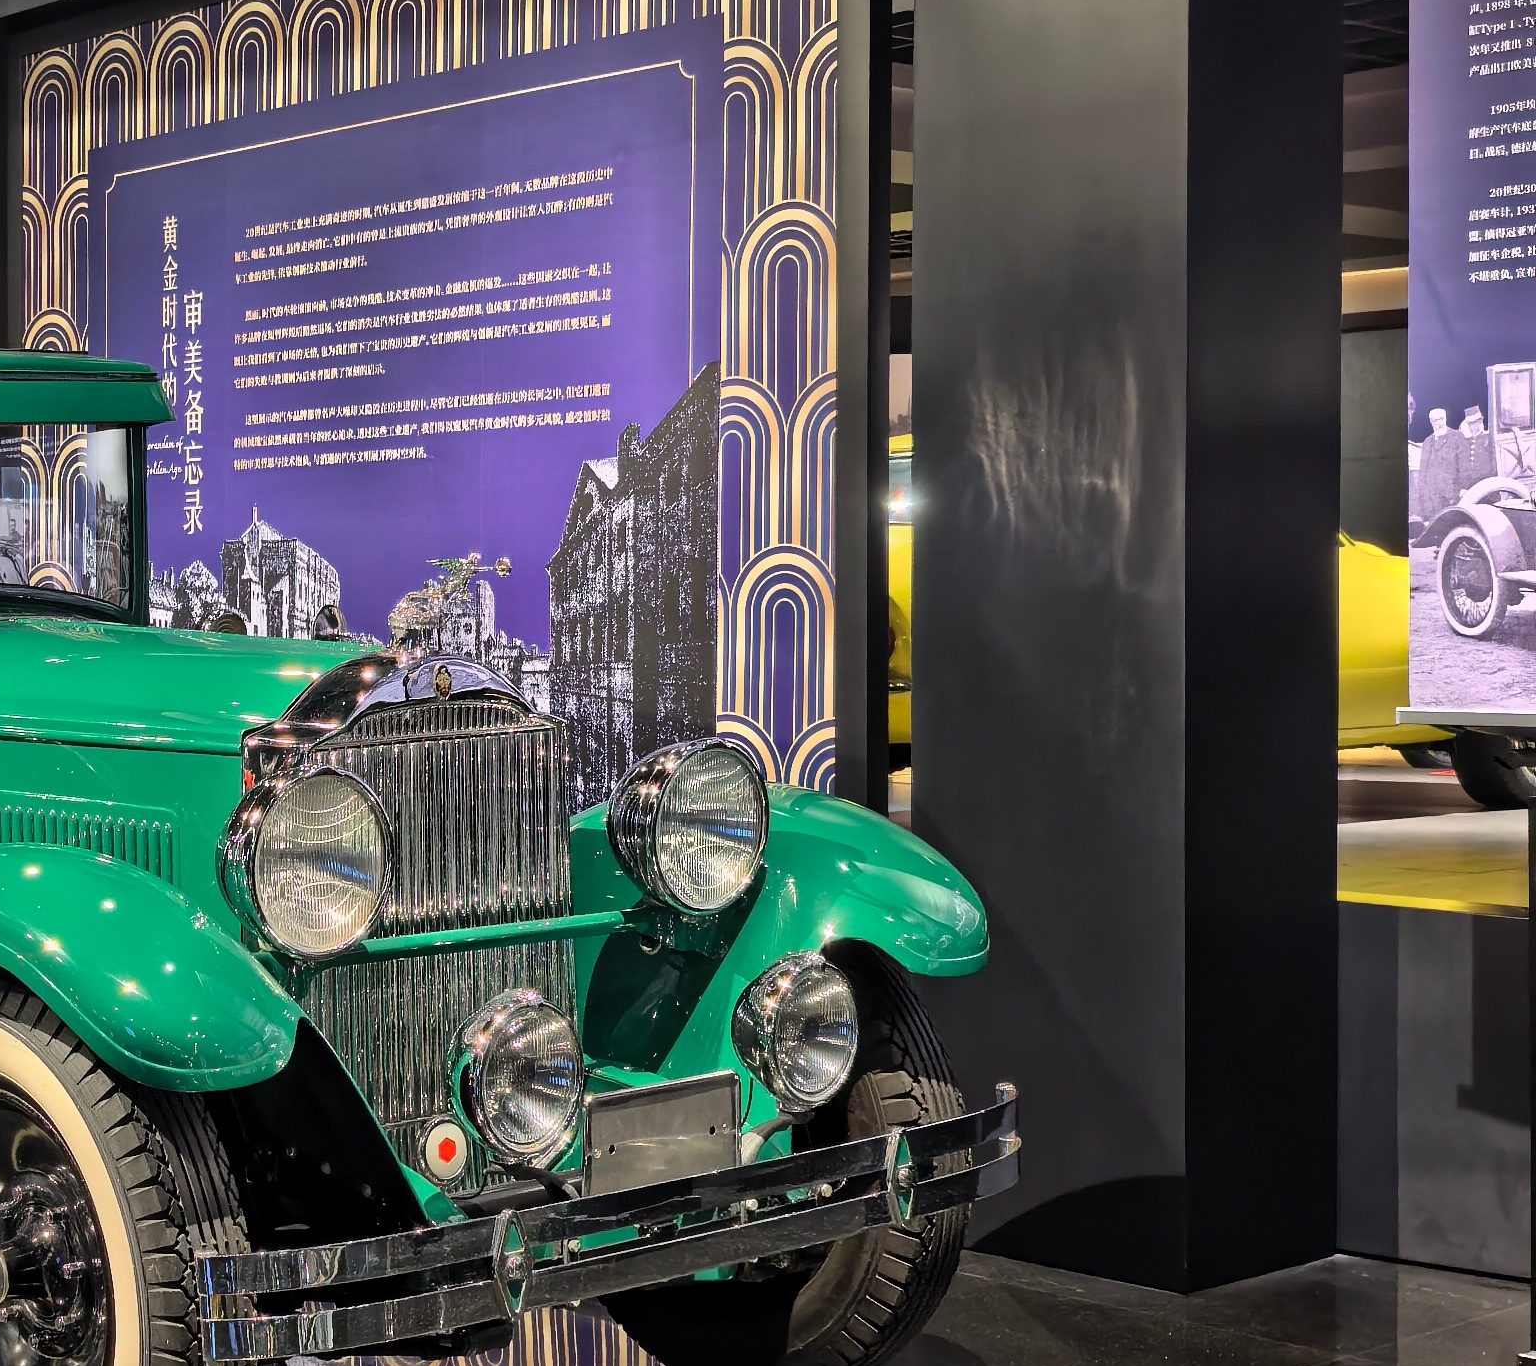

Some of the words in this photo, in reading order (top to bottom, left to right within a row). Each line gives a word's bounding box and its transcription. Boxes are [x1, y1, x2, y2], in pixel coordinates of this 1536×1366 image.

[1469, 56, 1536, 77] 产品出口欧美
[183, 289, 204, 535] 审美备忘录
